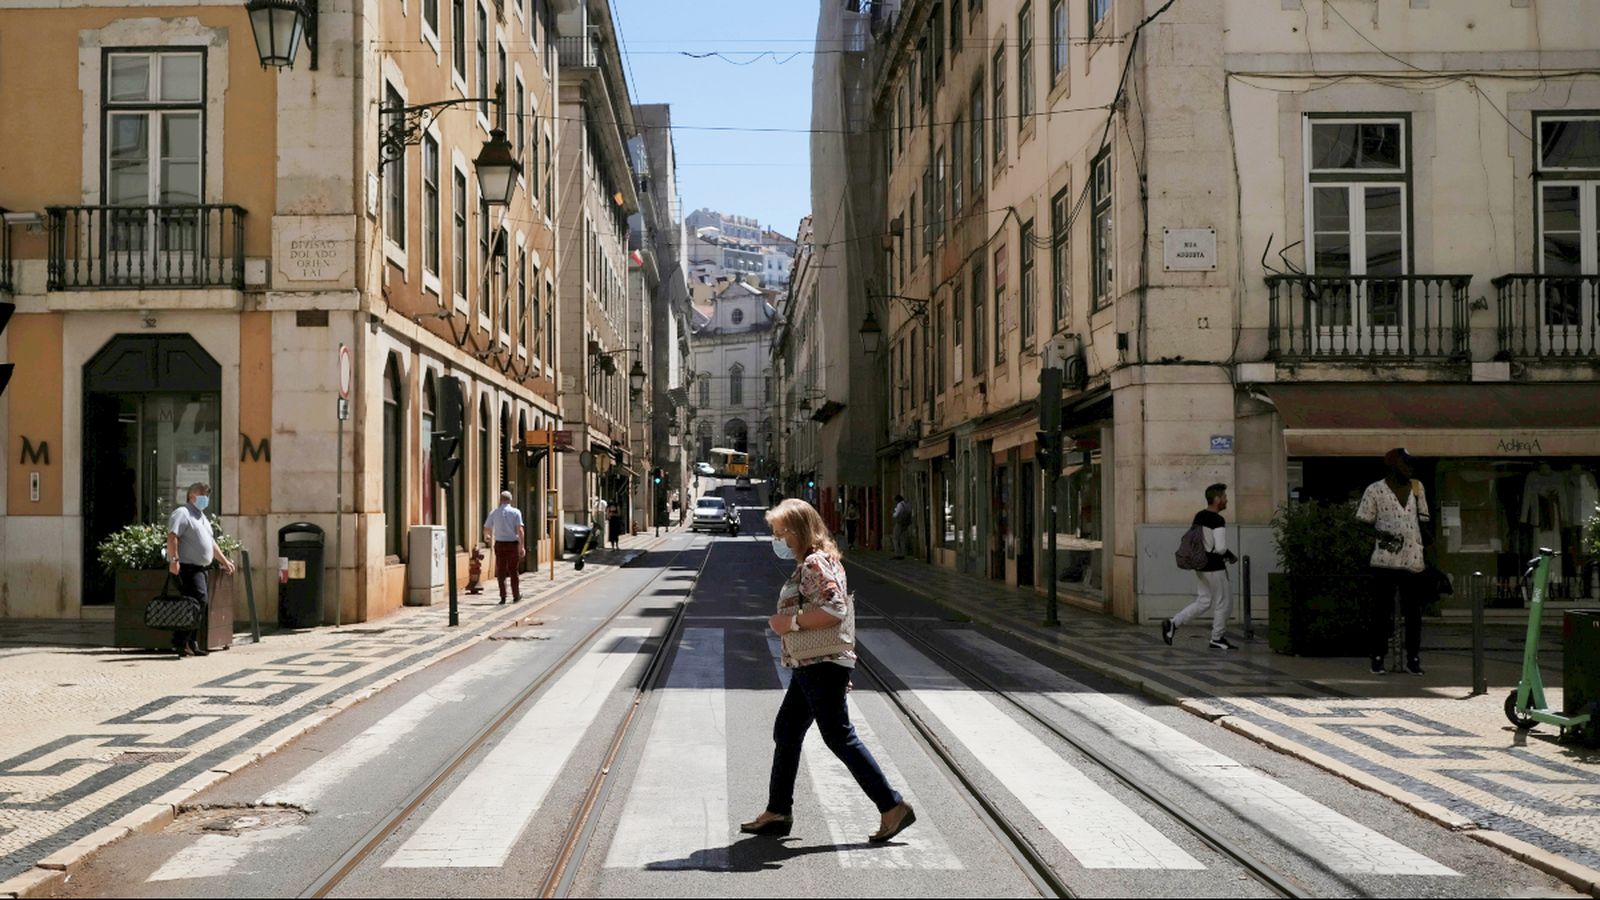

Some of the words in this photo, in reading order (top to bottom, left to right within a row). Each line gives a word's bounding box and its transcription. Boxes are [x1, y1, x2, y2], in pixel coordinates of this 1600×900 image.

[159, 408, 173, 422] M
[20, 434, 50, 465] M
[240, 432, 271, 463] M
